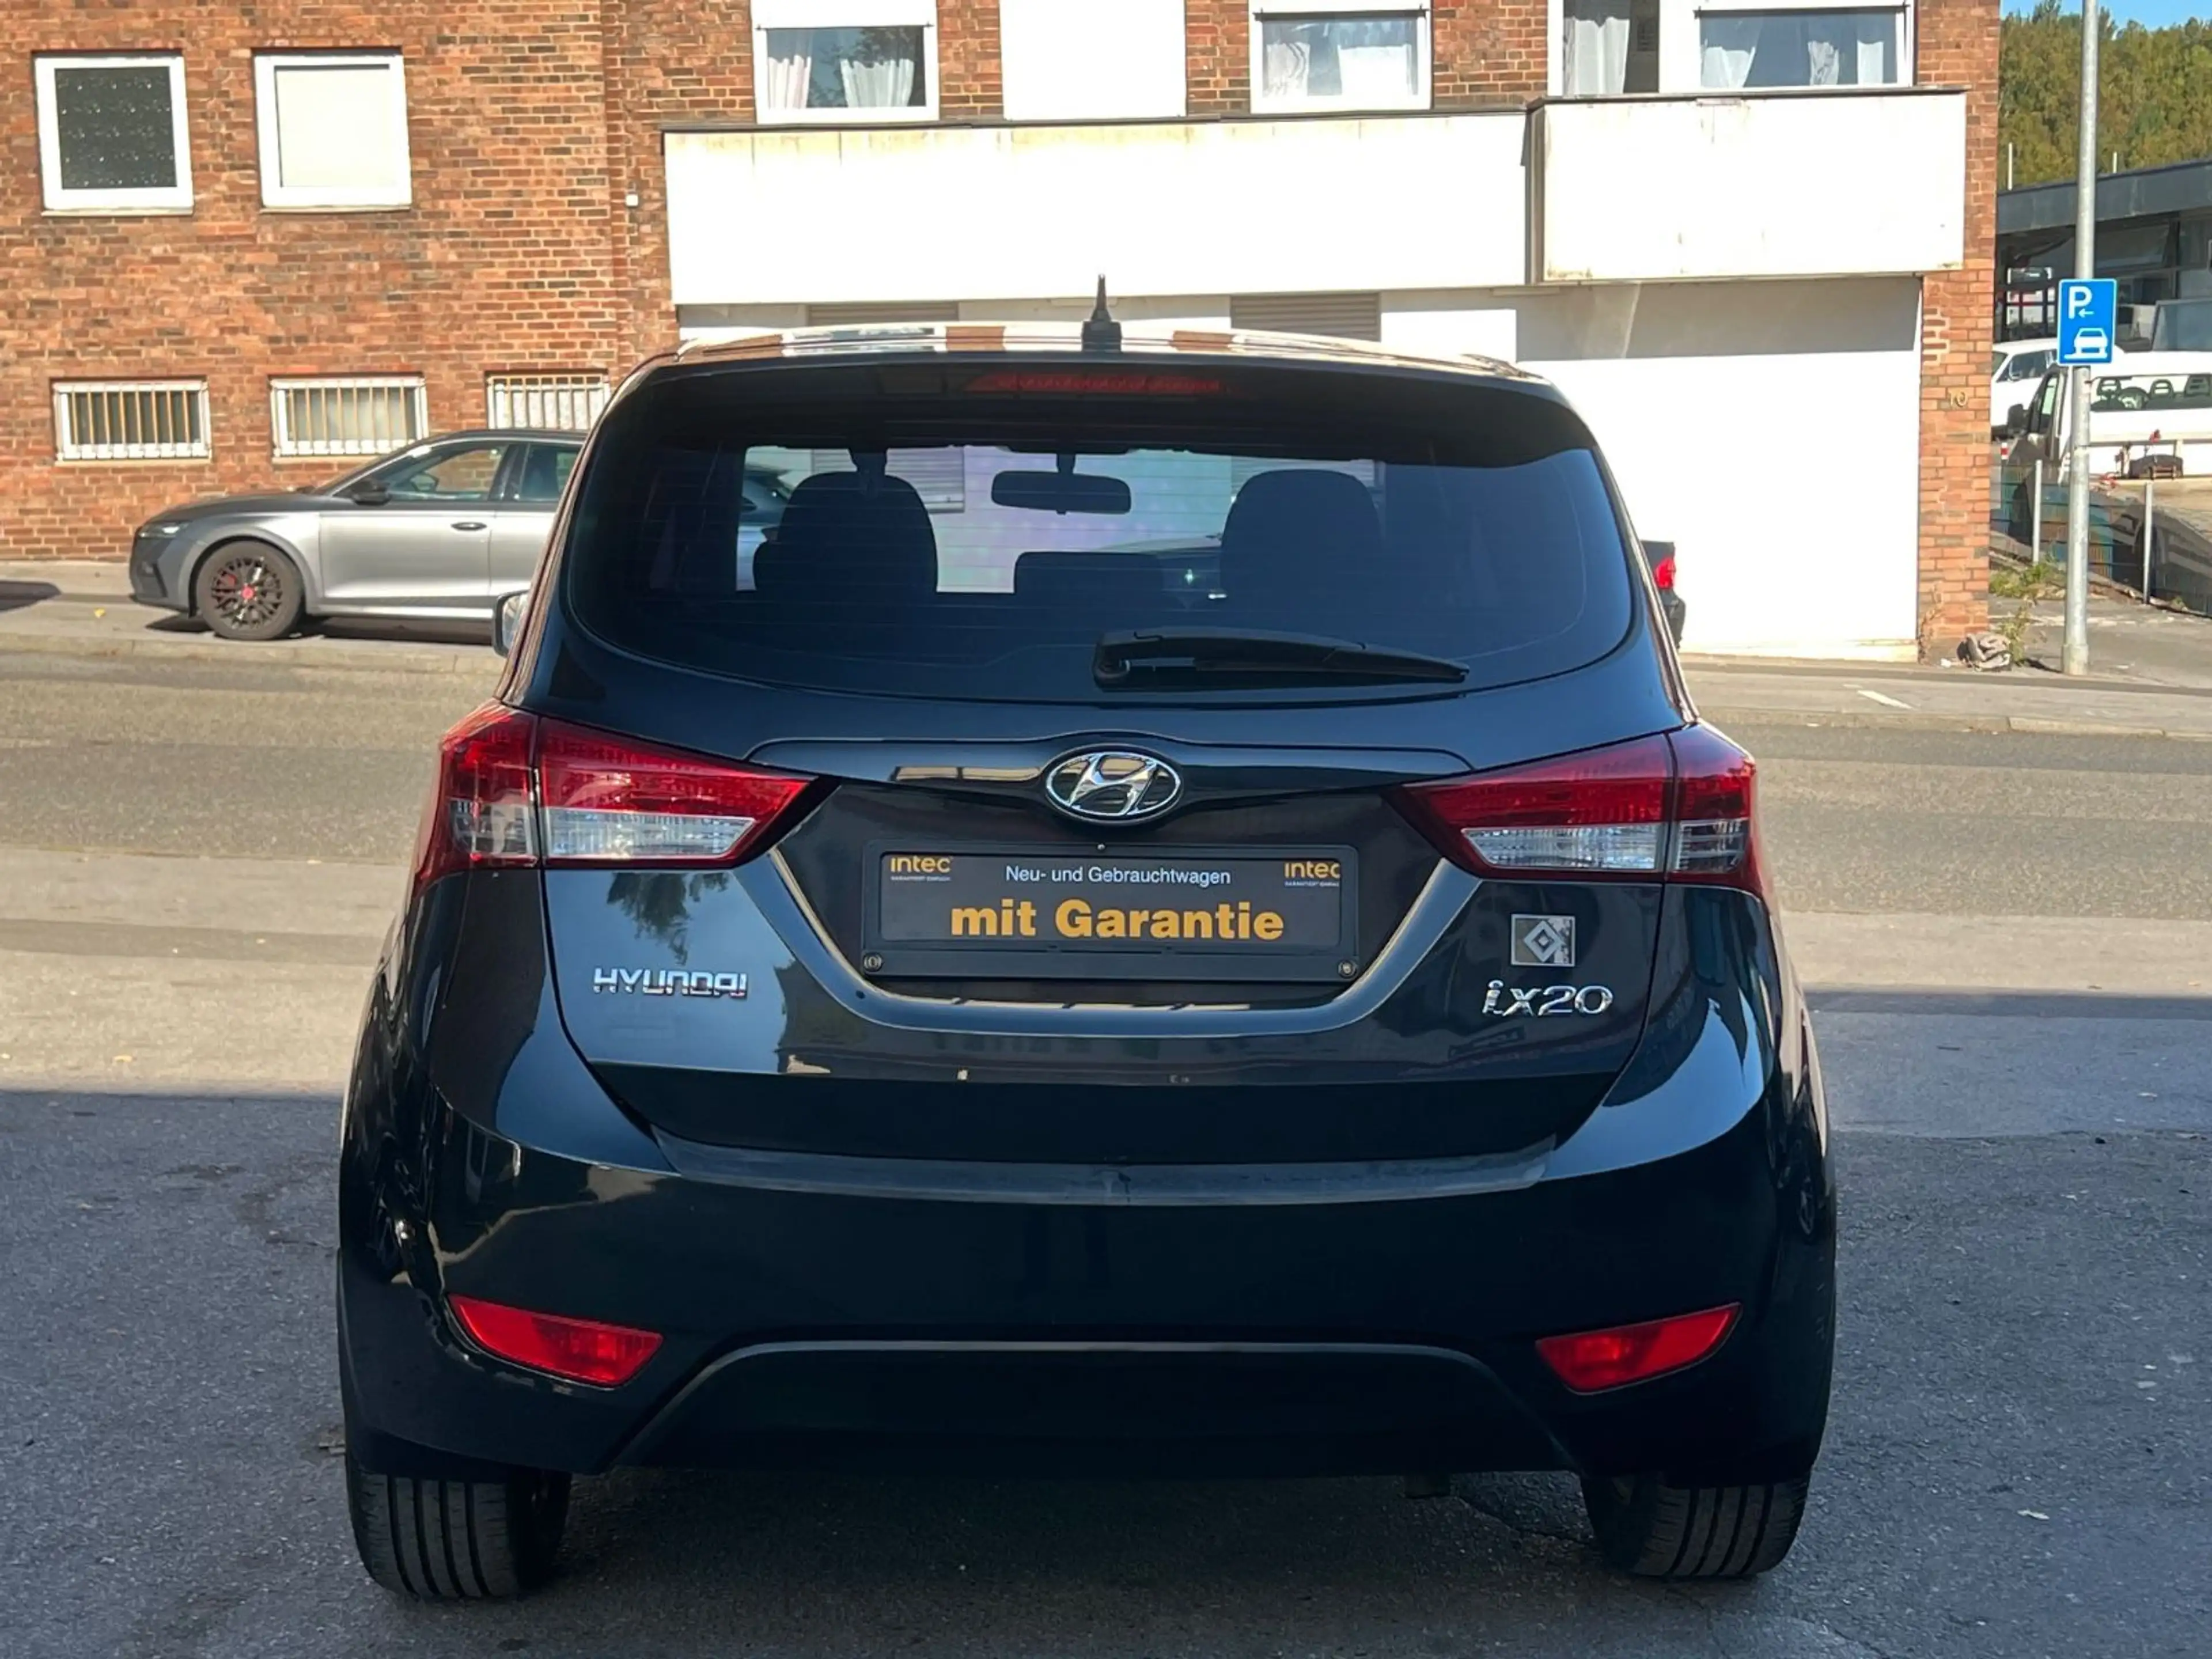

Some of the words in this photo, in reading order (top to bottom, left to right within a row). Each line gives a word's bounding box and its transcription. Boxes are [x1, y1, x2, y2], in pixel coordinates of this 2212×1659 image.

[2068, 286, 2093, 319] P
[891, 855, 951, 873] intec
[1006, 866, 1046, 882] Neu-
[1051, 866, 1083, 882] und
[1088, 866, 1231, 887] Gebrauchtwagen
[1284, 861, 1340, 879] intec
[951, 899, 1036, 936] mit
[1055, 899, 1284, 940] Garantie
[593, 968, 748, 998] HYUNDAI
[1482, 979, 1613, 1017] ix20
